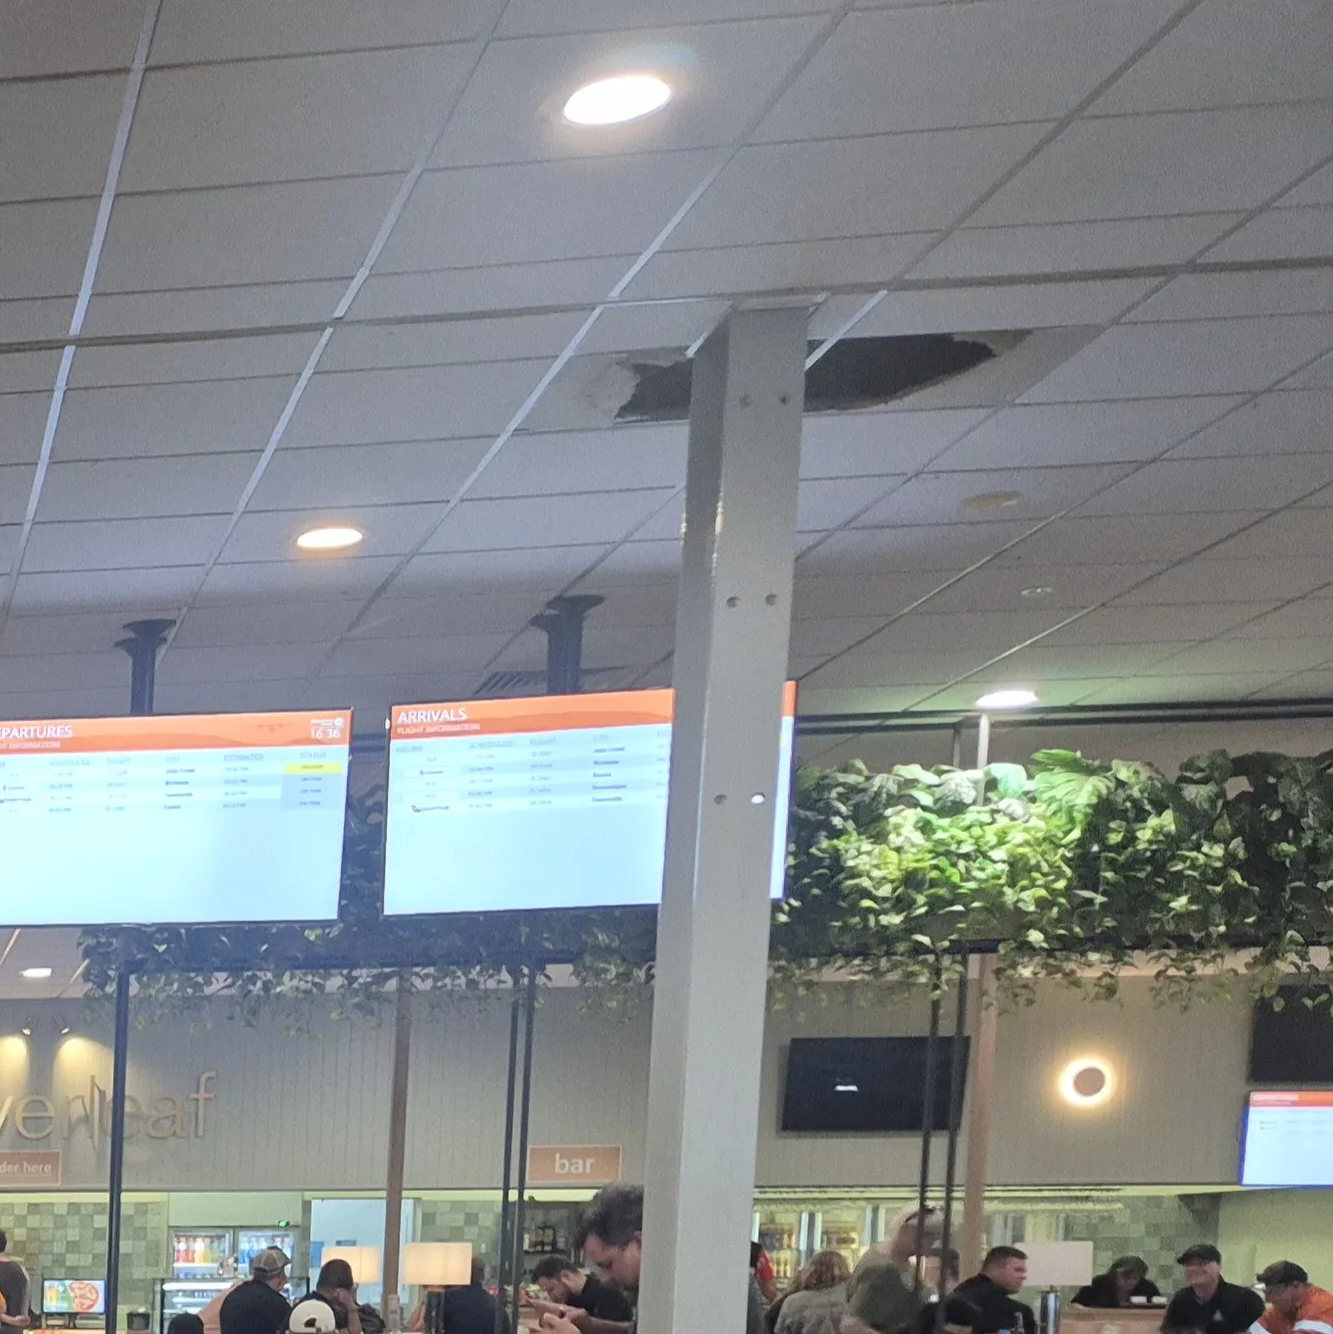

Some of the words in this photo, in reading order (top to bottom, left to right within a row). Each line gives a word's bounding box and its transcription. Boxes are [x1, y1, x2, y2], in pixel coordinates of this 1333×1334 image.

[397, 708, 467, 724] ARRIVALS
[23, 1161, 52, 1173] here
[555, 1152, 595, 1173] bar
